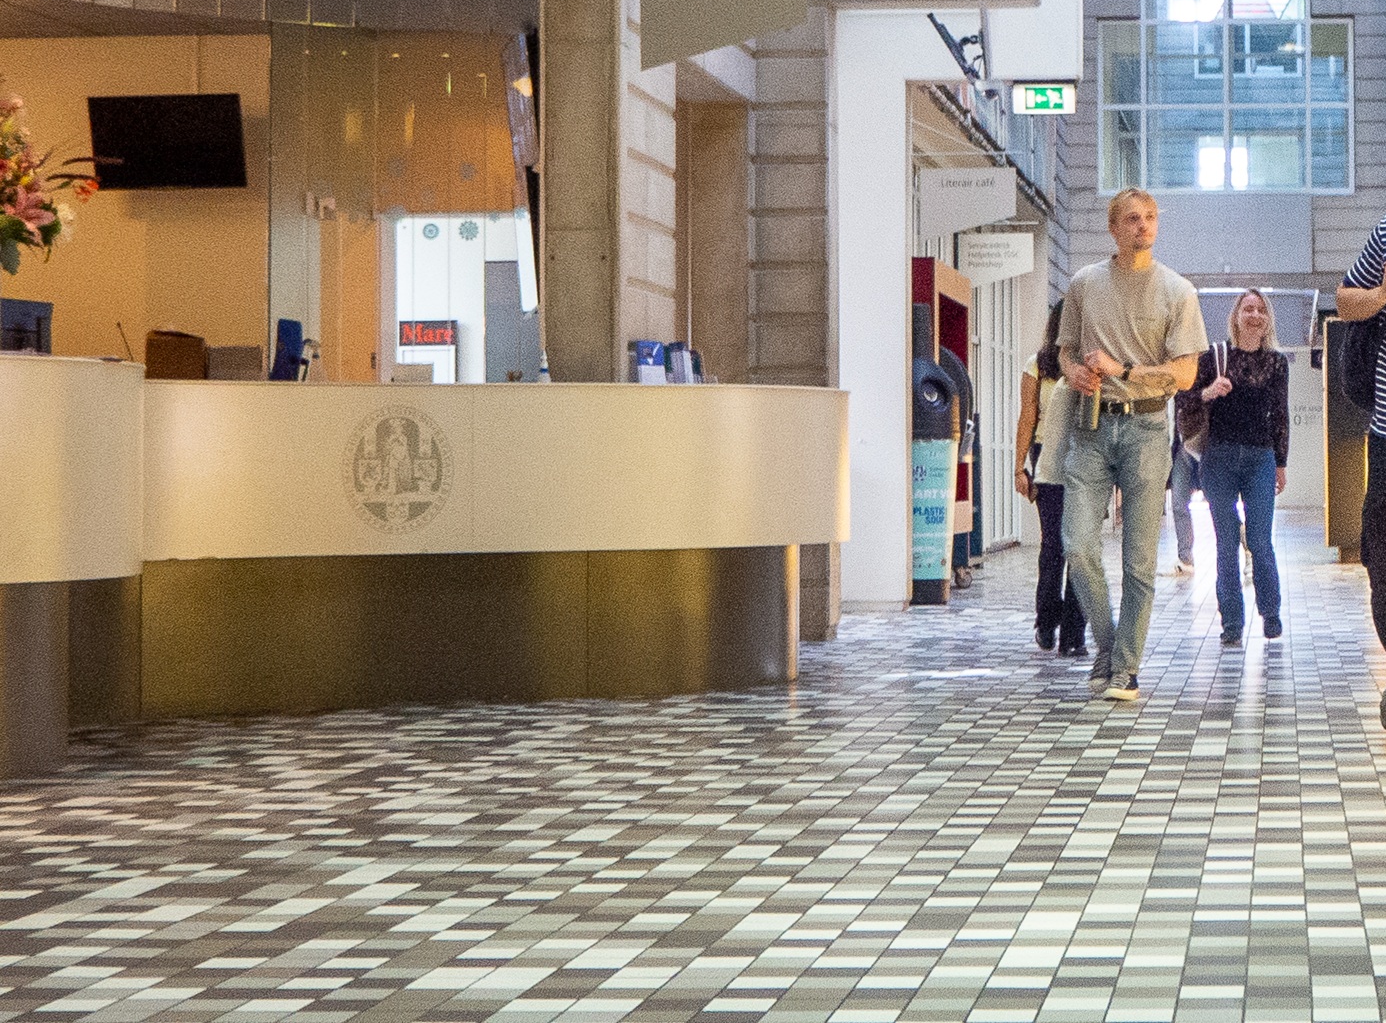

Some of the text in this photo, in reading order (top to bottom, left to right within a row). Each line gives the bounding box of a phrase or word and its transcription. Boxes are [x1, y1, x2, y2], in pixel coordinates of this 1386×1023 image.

[940, 176, 996, 188] Literair café
[402, 323, 454, 343] Mare
